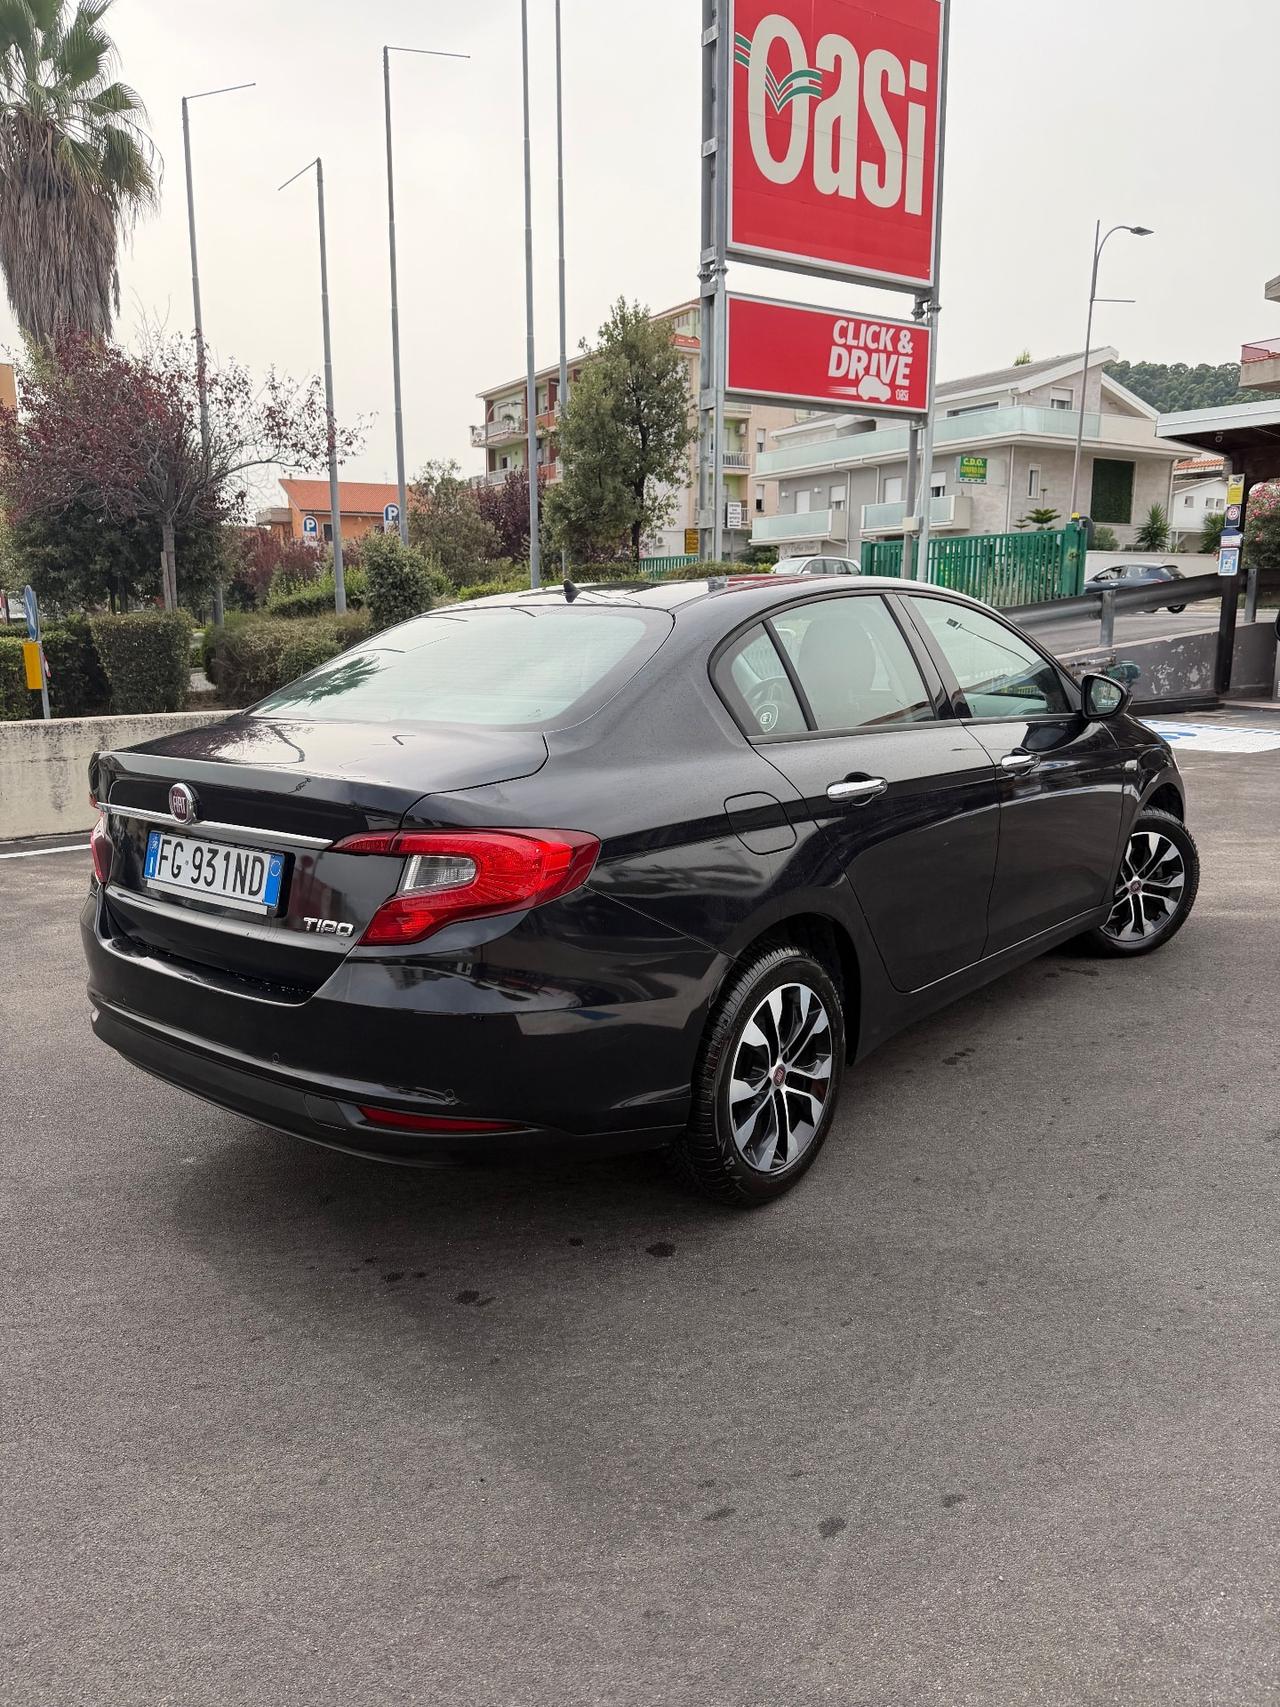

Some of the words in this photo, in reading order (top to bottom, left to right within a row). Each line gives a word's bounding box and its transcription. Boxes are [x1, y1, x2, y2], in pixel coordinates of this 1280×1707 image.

[748, 14, 928, 216] Oasi
[833, 319, 896, 352] CLICK
[897, 329, 914, 354] &
[828, 345, 913, 387] DRIVE
[306, 520, 315, 531] P
[389, 507, 398, 520] P
[157, 838, 184, 879] FG
[190, 846, 265, 897] 931ND
[303, 917, 354, 936] TIPO
